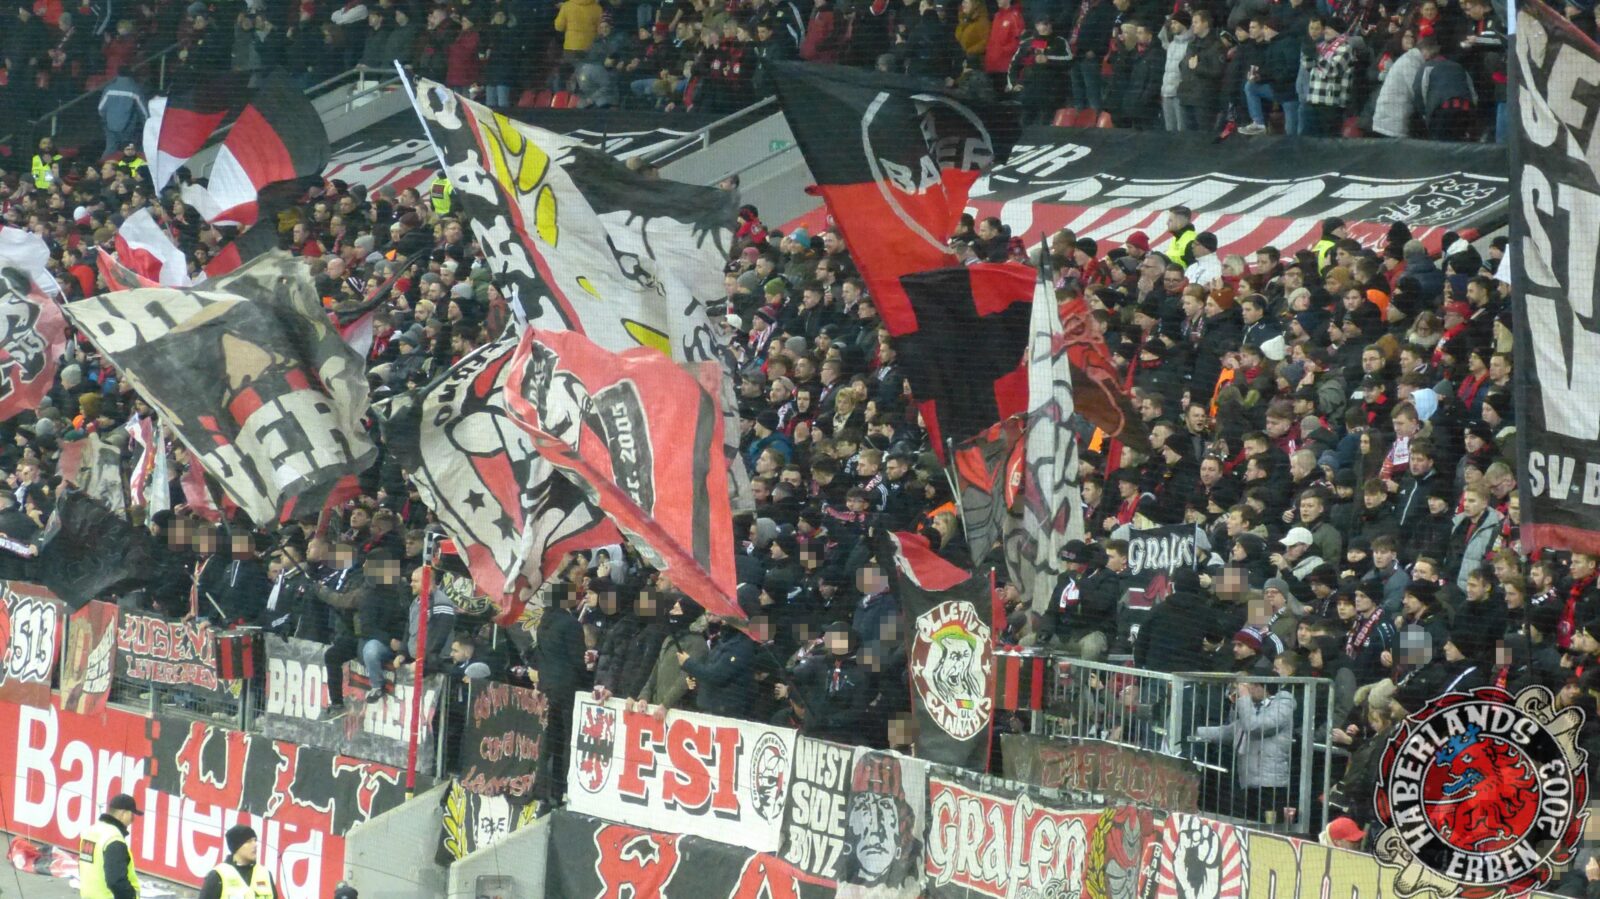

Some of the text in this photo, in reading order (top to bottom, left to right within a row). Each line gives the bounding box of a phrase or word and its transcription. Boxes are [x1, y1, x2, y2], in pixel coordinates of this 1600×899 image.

[610, 400, 637, 464] 2005
[617, 709, 745, 822] FSI
[796, 738, 851, 791] WEST
[792, 781, 846, 837] SIDE
[785, 824, 844, 878] BOYZ
